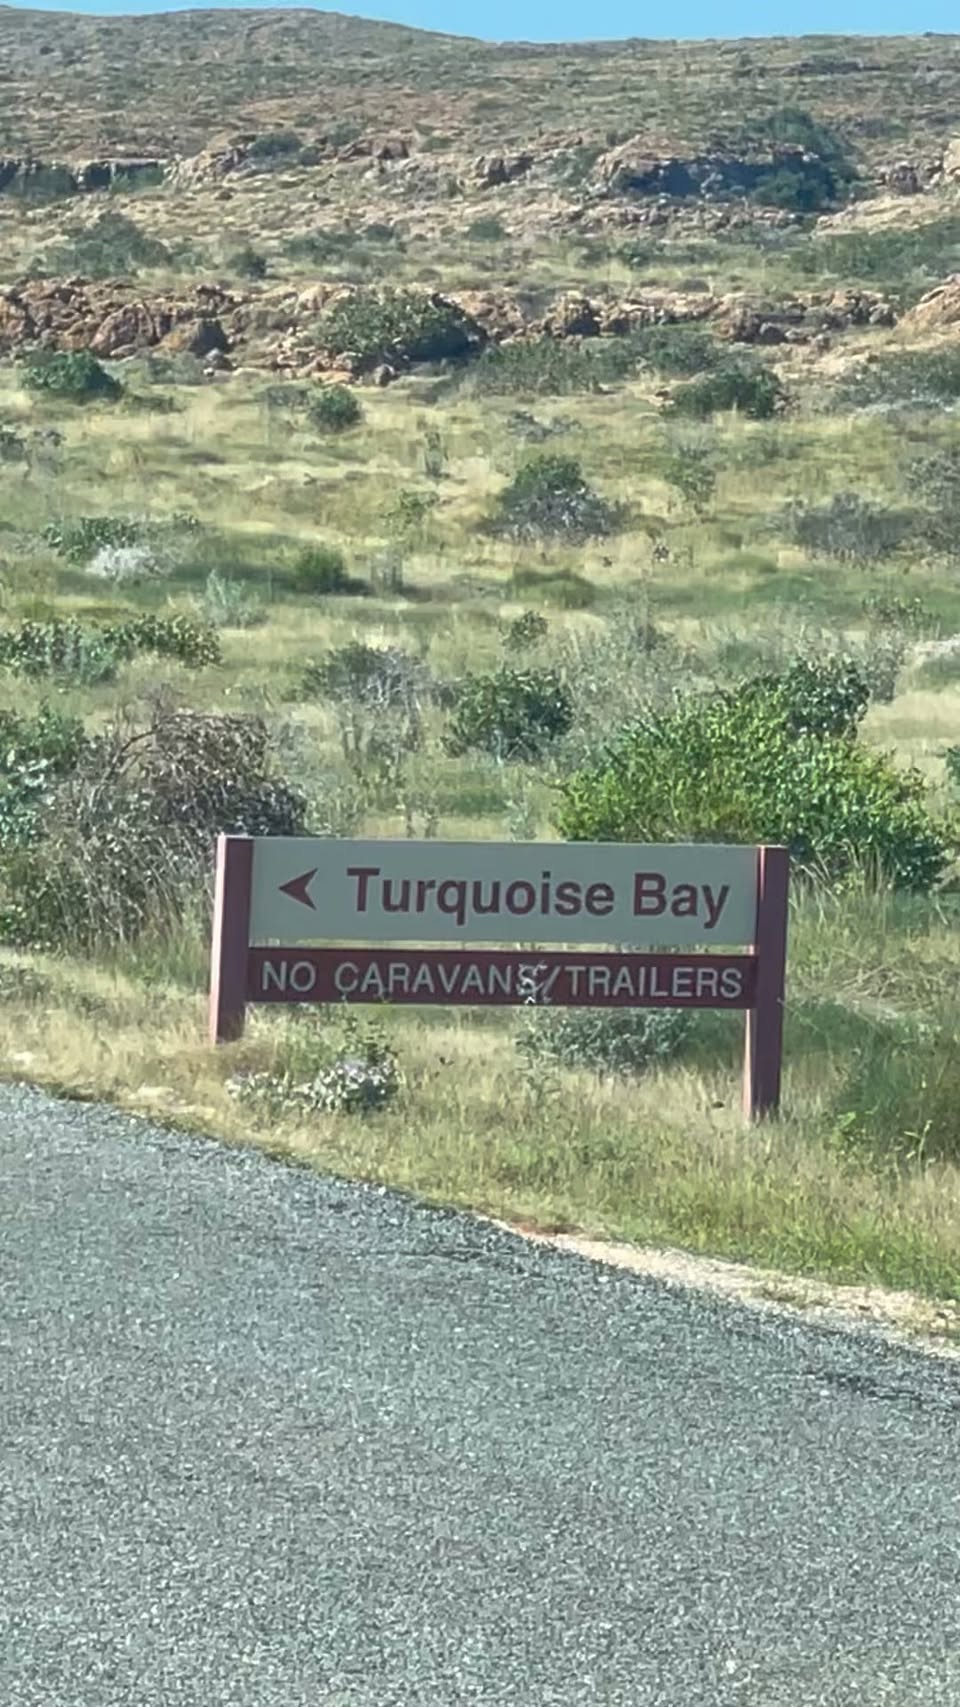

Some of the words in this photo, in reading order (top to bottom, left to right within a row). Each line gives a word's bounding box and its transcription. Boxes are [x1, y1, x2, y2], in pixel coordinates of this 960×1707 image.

[346, 867, 615, 926] Turquoise
[633, 872, 731, 929] Bay
[262, 961, 316, 992] NO
